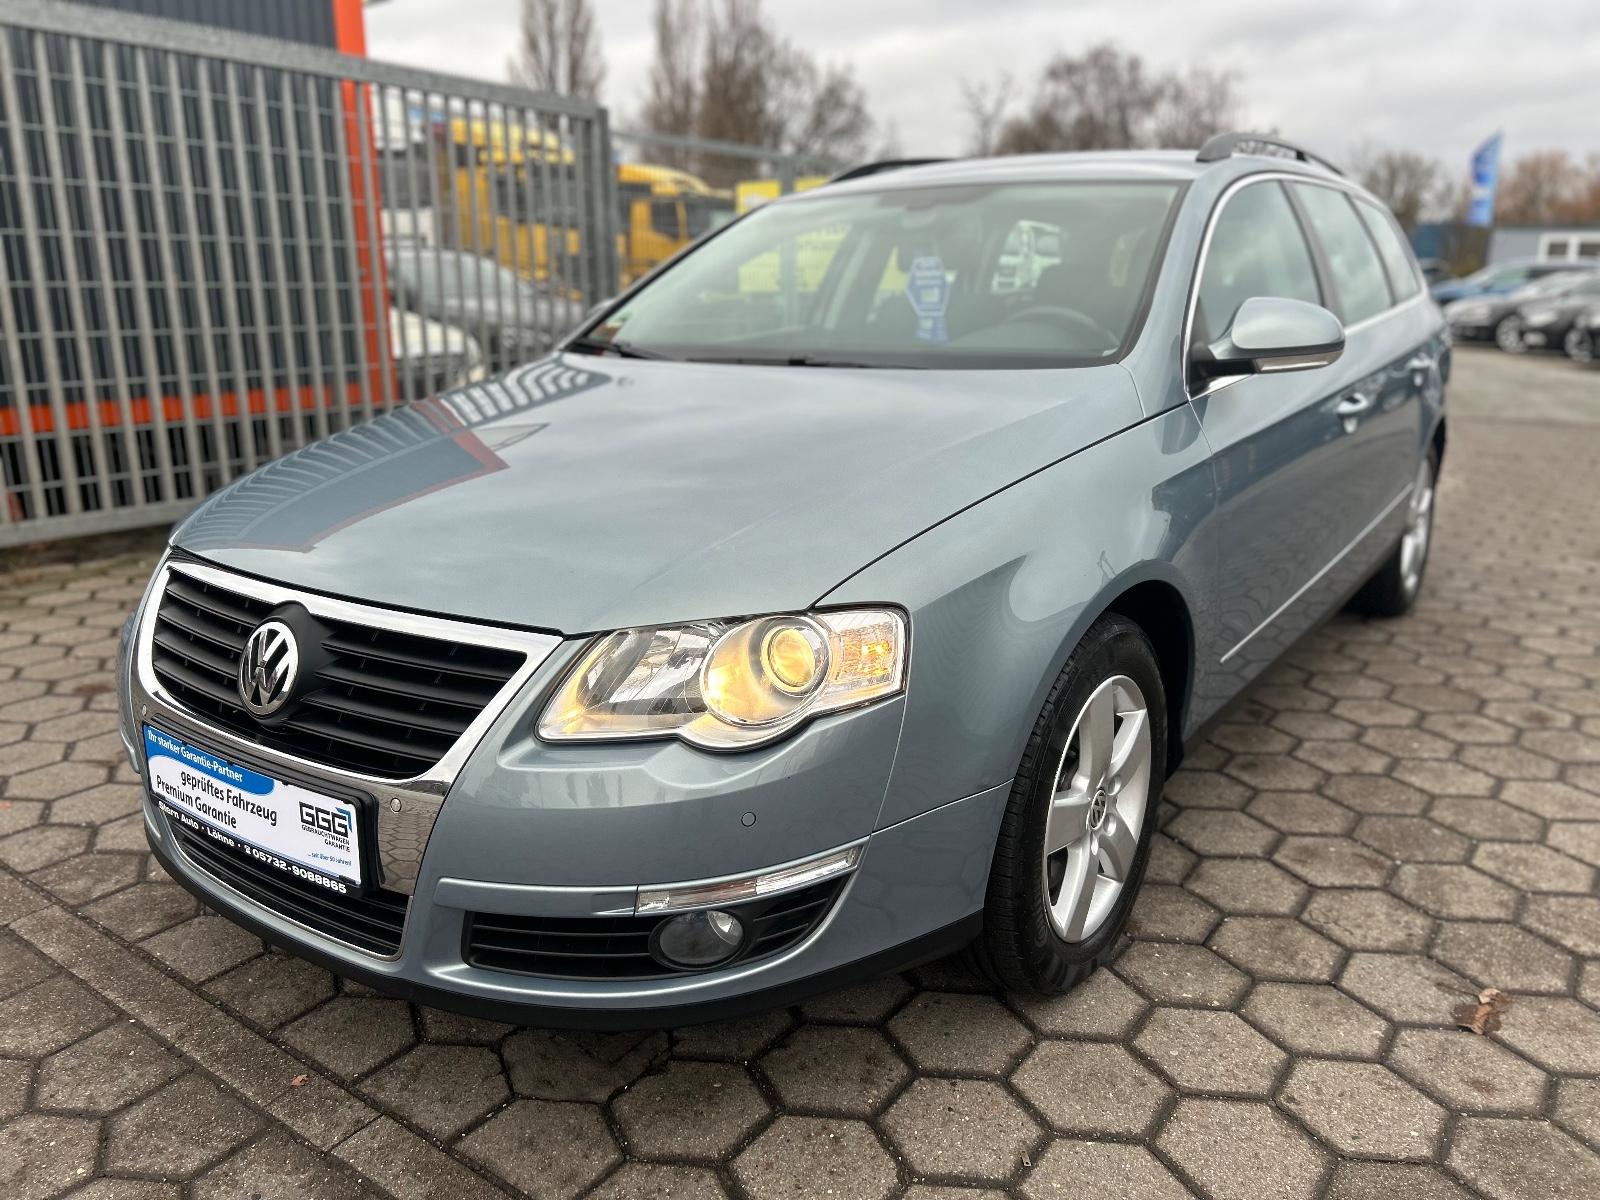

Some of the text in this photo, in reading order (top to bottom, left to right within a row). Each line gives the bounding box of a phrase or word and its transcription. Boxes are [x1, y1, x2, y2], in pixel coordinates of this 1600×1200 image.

[148, 729, 243, 782] Ihr starker Garantie-Partner
[157, 775, 237, 828] Premium Garantie
[181, 771, 277, 826] geprüftes Fahrzeug
[299, 801, 350, 838] GGG
[158, 800, 180, 819] Stern
[181, 813, 199, 830] Auto
[207, 827, 235, 847] Löhne
[301, 824, 350, 845] GEBRAUCHTWAGEN
[324, 839, 350, 852] GARANTIE
